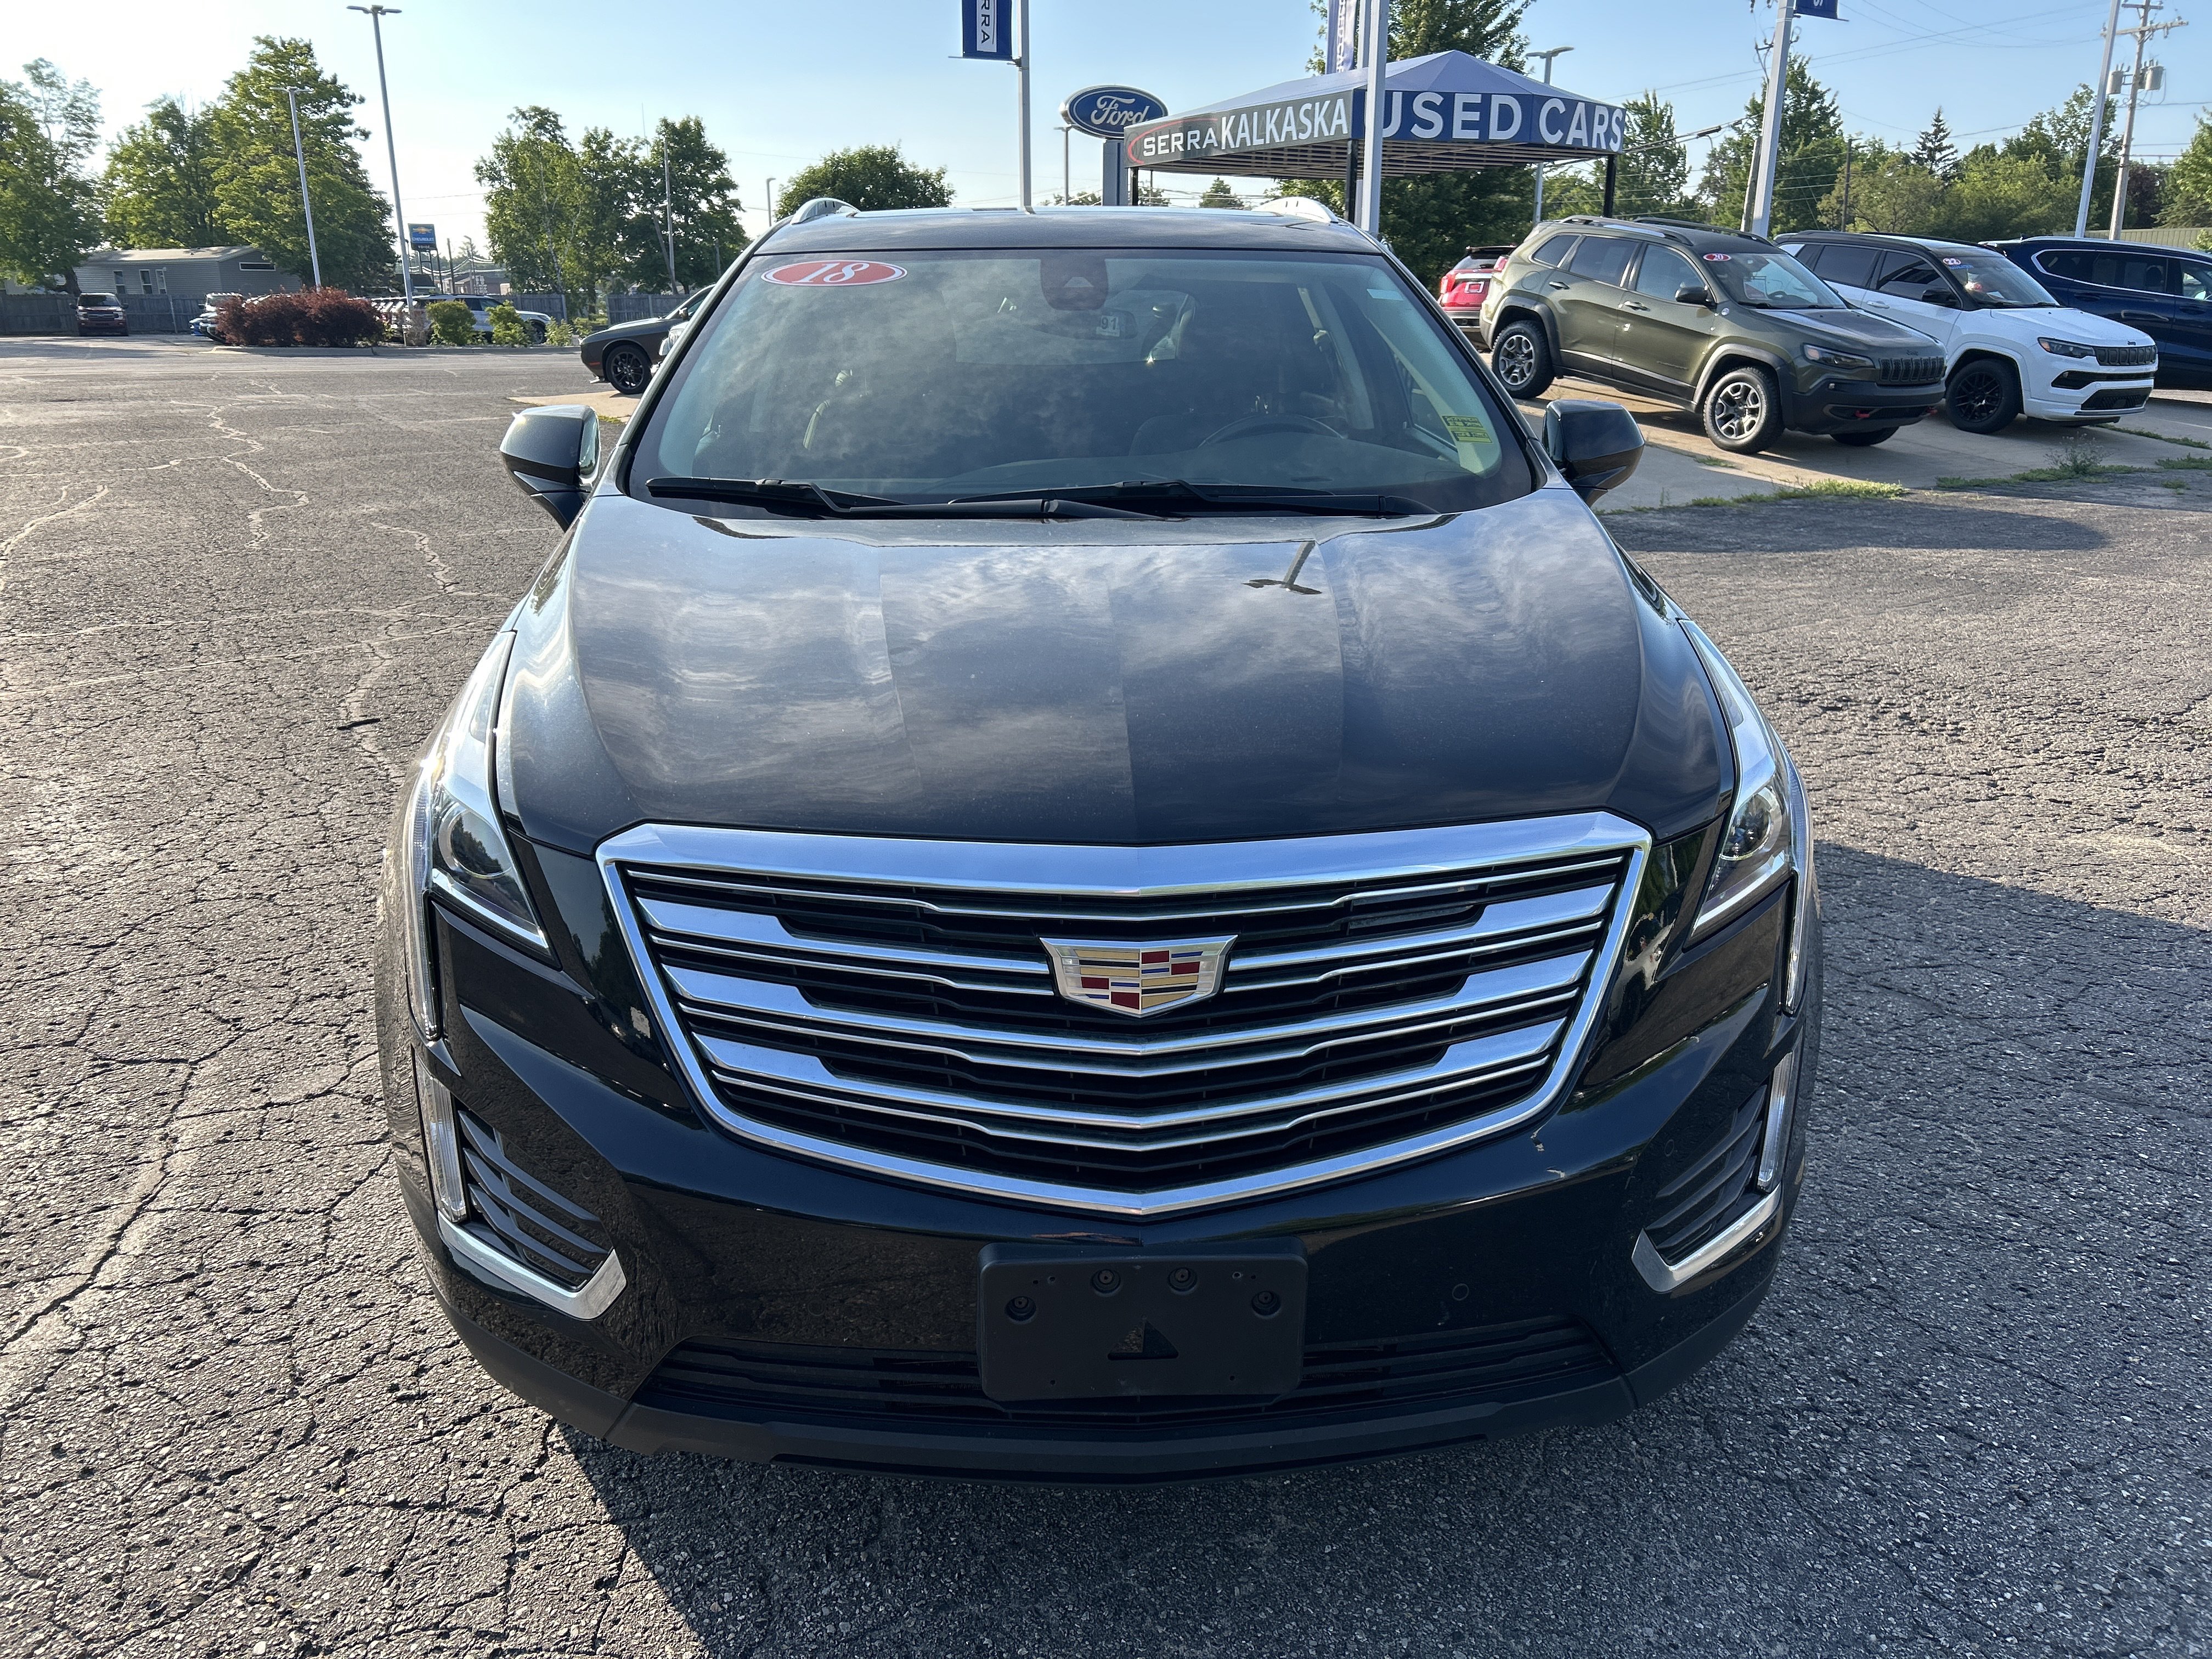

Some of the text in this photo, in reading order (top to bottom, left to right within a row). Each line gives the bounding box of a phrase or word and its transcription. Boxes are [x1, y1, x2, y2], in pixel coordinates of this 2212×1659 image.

[1091, 95, 1150, 126] Ford
[1538, 98, 1623, 152] CARS
[1143, 98, 1348, 157] SERRA KALKASKA
[792, 262, 870, 283] 18
[1101, 317, 1116, 330] 91
